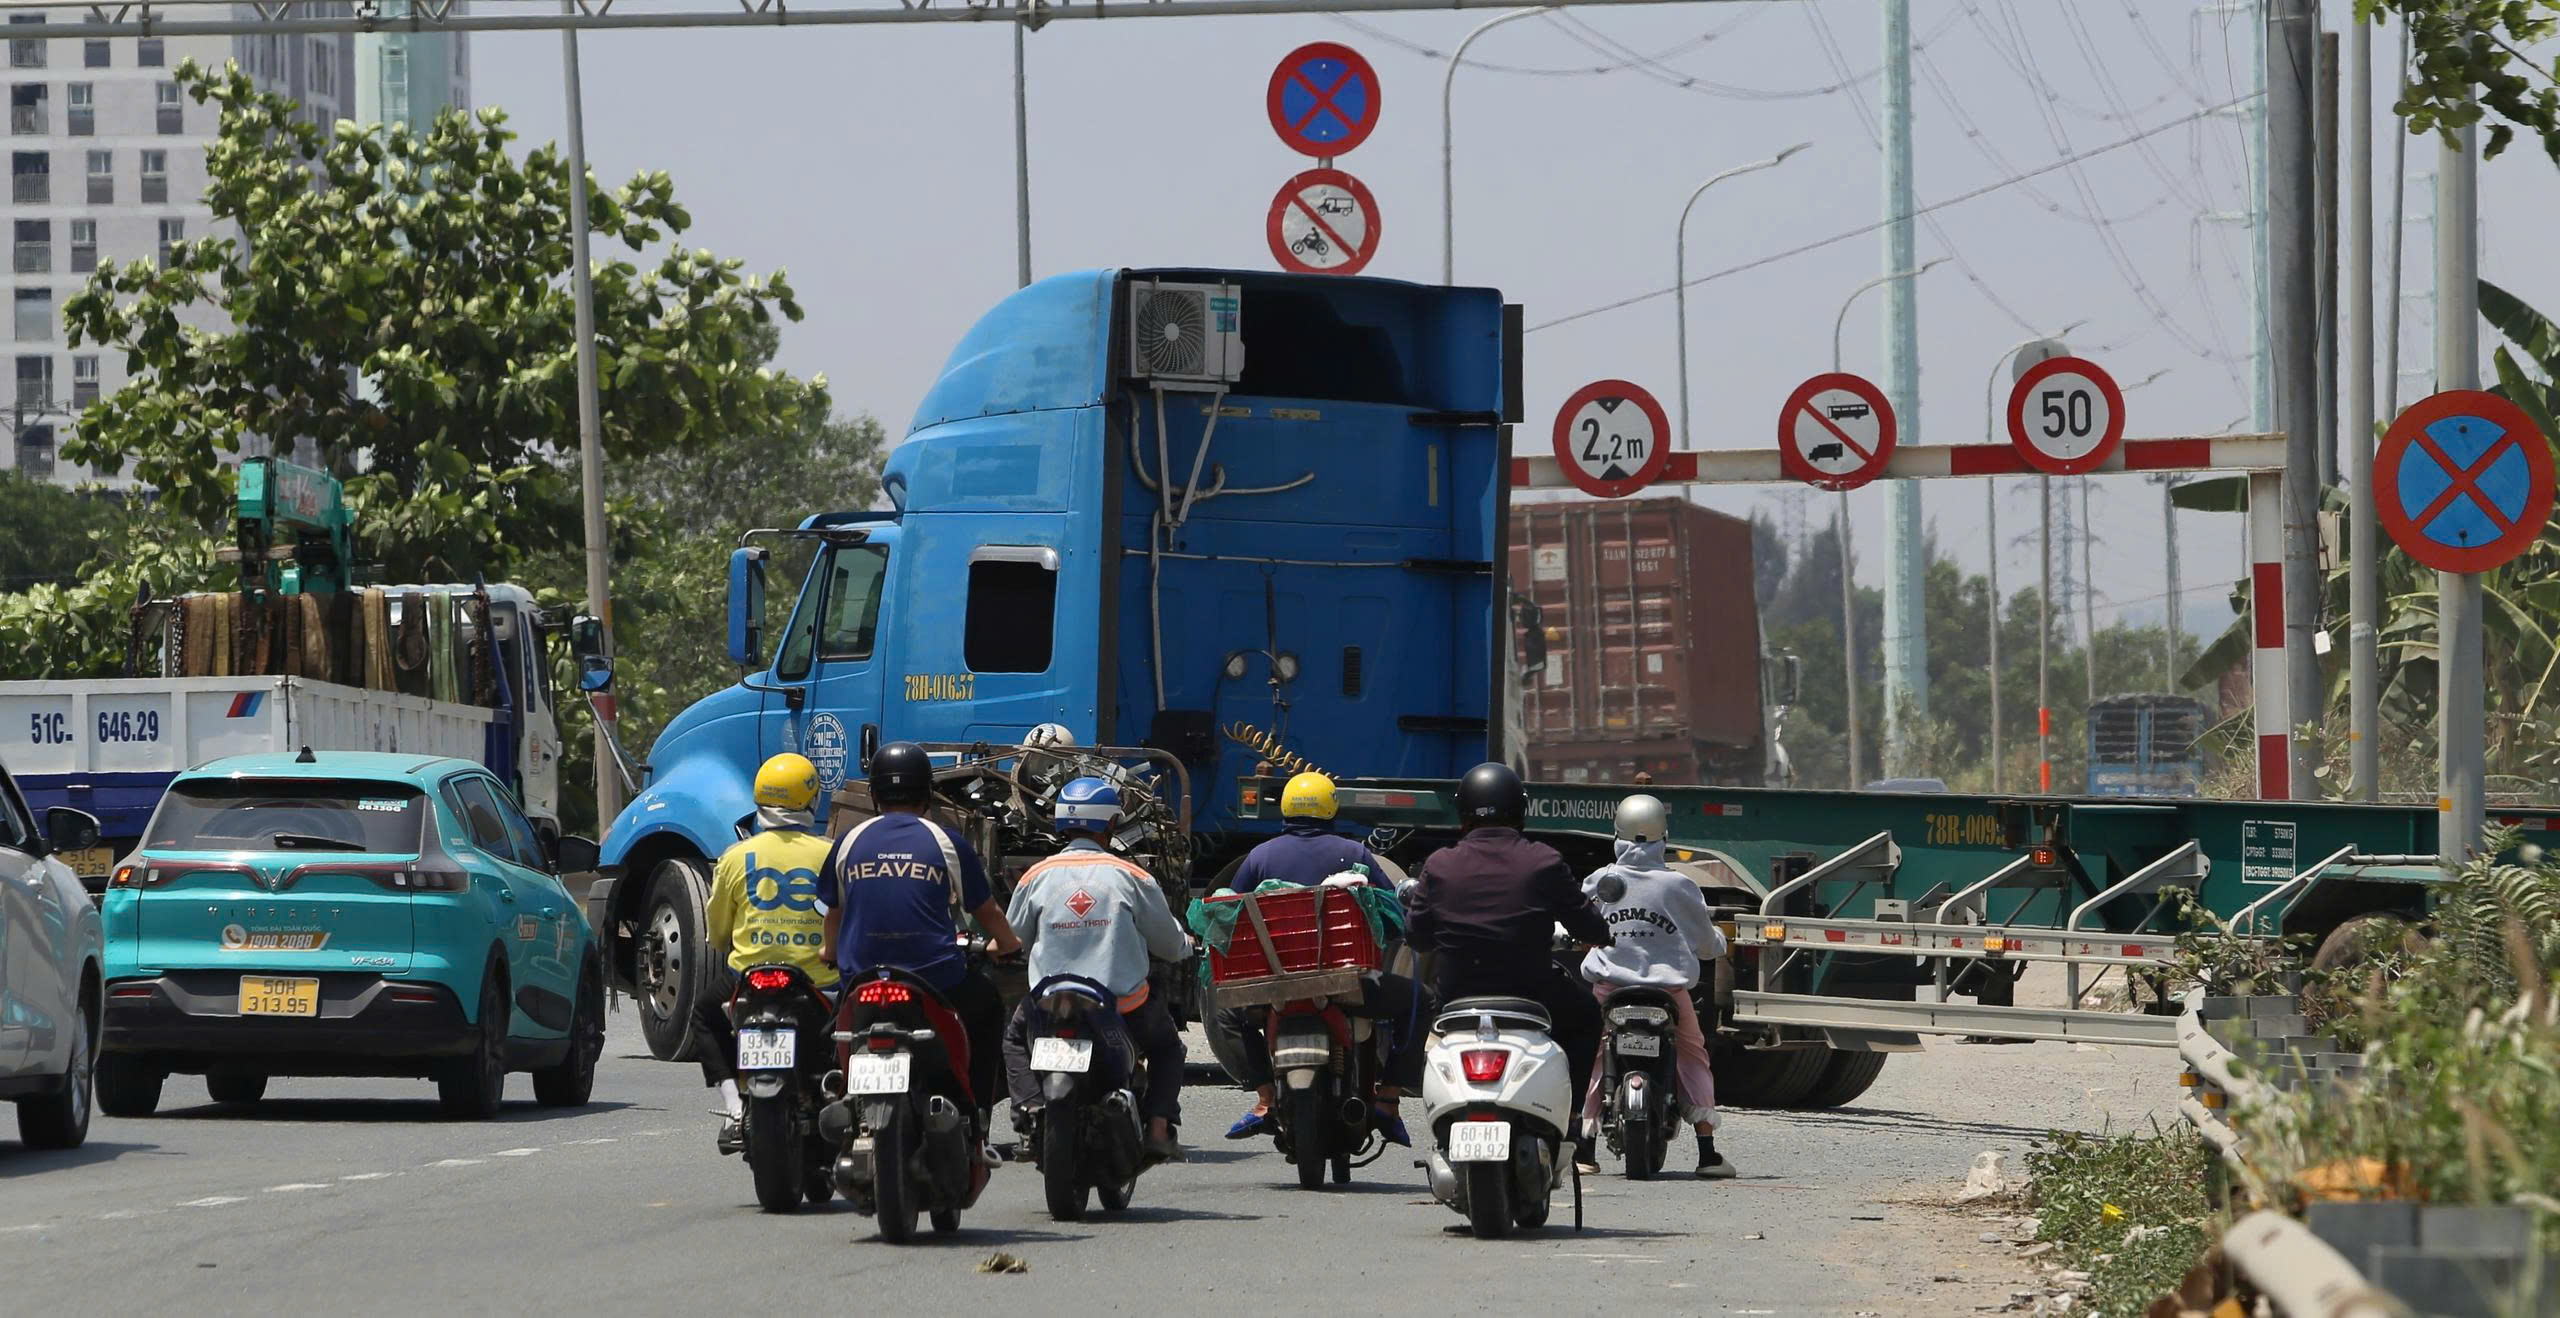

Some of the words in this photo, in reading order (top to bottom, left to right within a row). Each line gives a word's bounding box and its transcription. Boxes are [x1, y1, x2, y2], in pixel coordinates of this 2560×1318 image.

[2042, 389, 2092, 438] 50
[904, 673, 974, 701] 78H-016.57
[98, 710, 159, 743] 646.29
[745, 852, 819, 911] be
[847, 862, 943, 885] HEAVEN
[1606, 908, 1678, 934] ORMSTU
[263, 979, 296, 996] 50H
[247, 996, 308, 1014] 313.95
[741, 1050, 792, 1067] 835.06
[1455, 1144, 1505, 1158] 198.92
